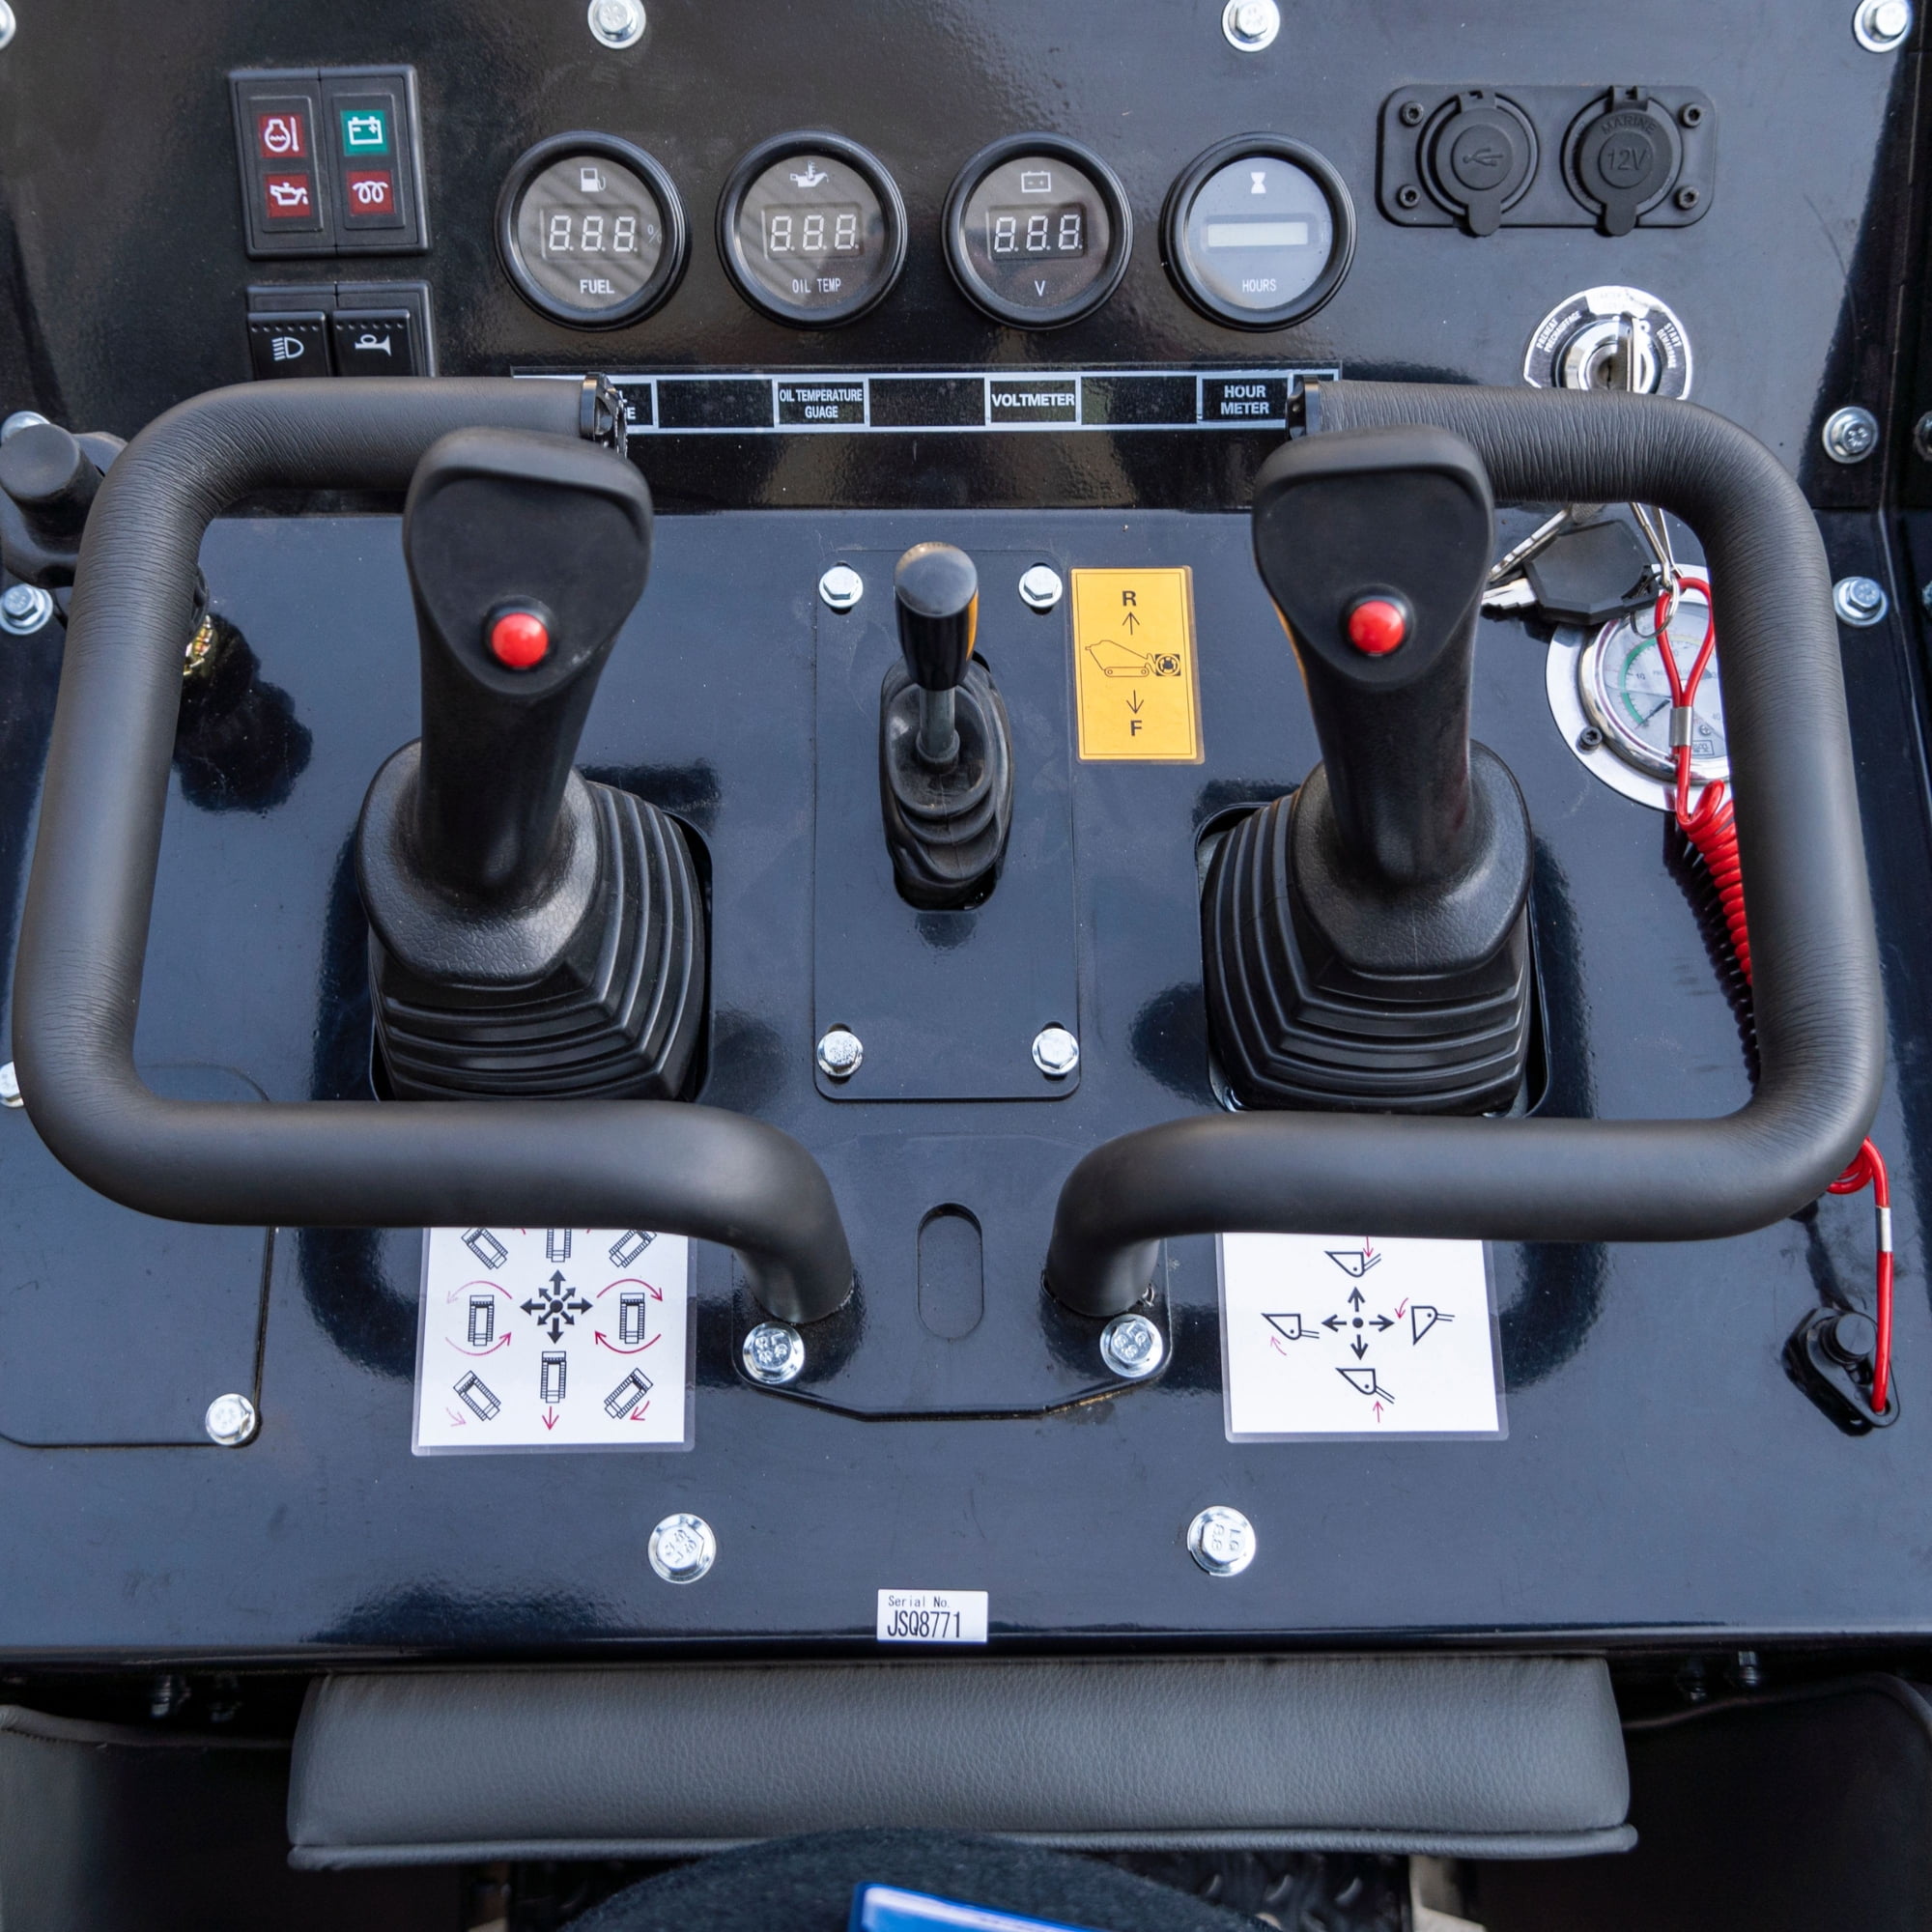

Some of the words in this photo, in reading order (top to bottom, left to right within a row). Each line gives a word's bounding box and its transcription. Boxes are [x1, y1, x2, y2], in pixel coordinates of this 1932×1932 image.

[1601, 115, 1656, 134] MARINE
[1607, 148, 1647, 171] 12V
[579, 279, 615, 295] FUEL
[792, 279, 810, 295] OIL
[817, 278, 841, 294] TEMP
[1035, 280, 1046, 298] V
[1241, 278, 1277, 294] HOURS
[1663, 322, 1682, 348] START
[779, 390, 795, 402] OIL
[795, 388, 863, 402] TEMPERATURE
[991, 392, 1075, 408] VOLTMETER
[1224, 385, 1266, 399] HOUR
[804, 405, 838, 419] GUAGE
[1220, 401, 1269, 415] METER
[1122, 590, 1137, 607] R
[1130, 720, 1143, 737] F
[888, 1595, 925, 1607] Serial
[933, 1596, 950, 1608] No.
[887, 1609, 960, 1638] JSQ8771
